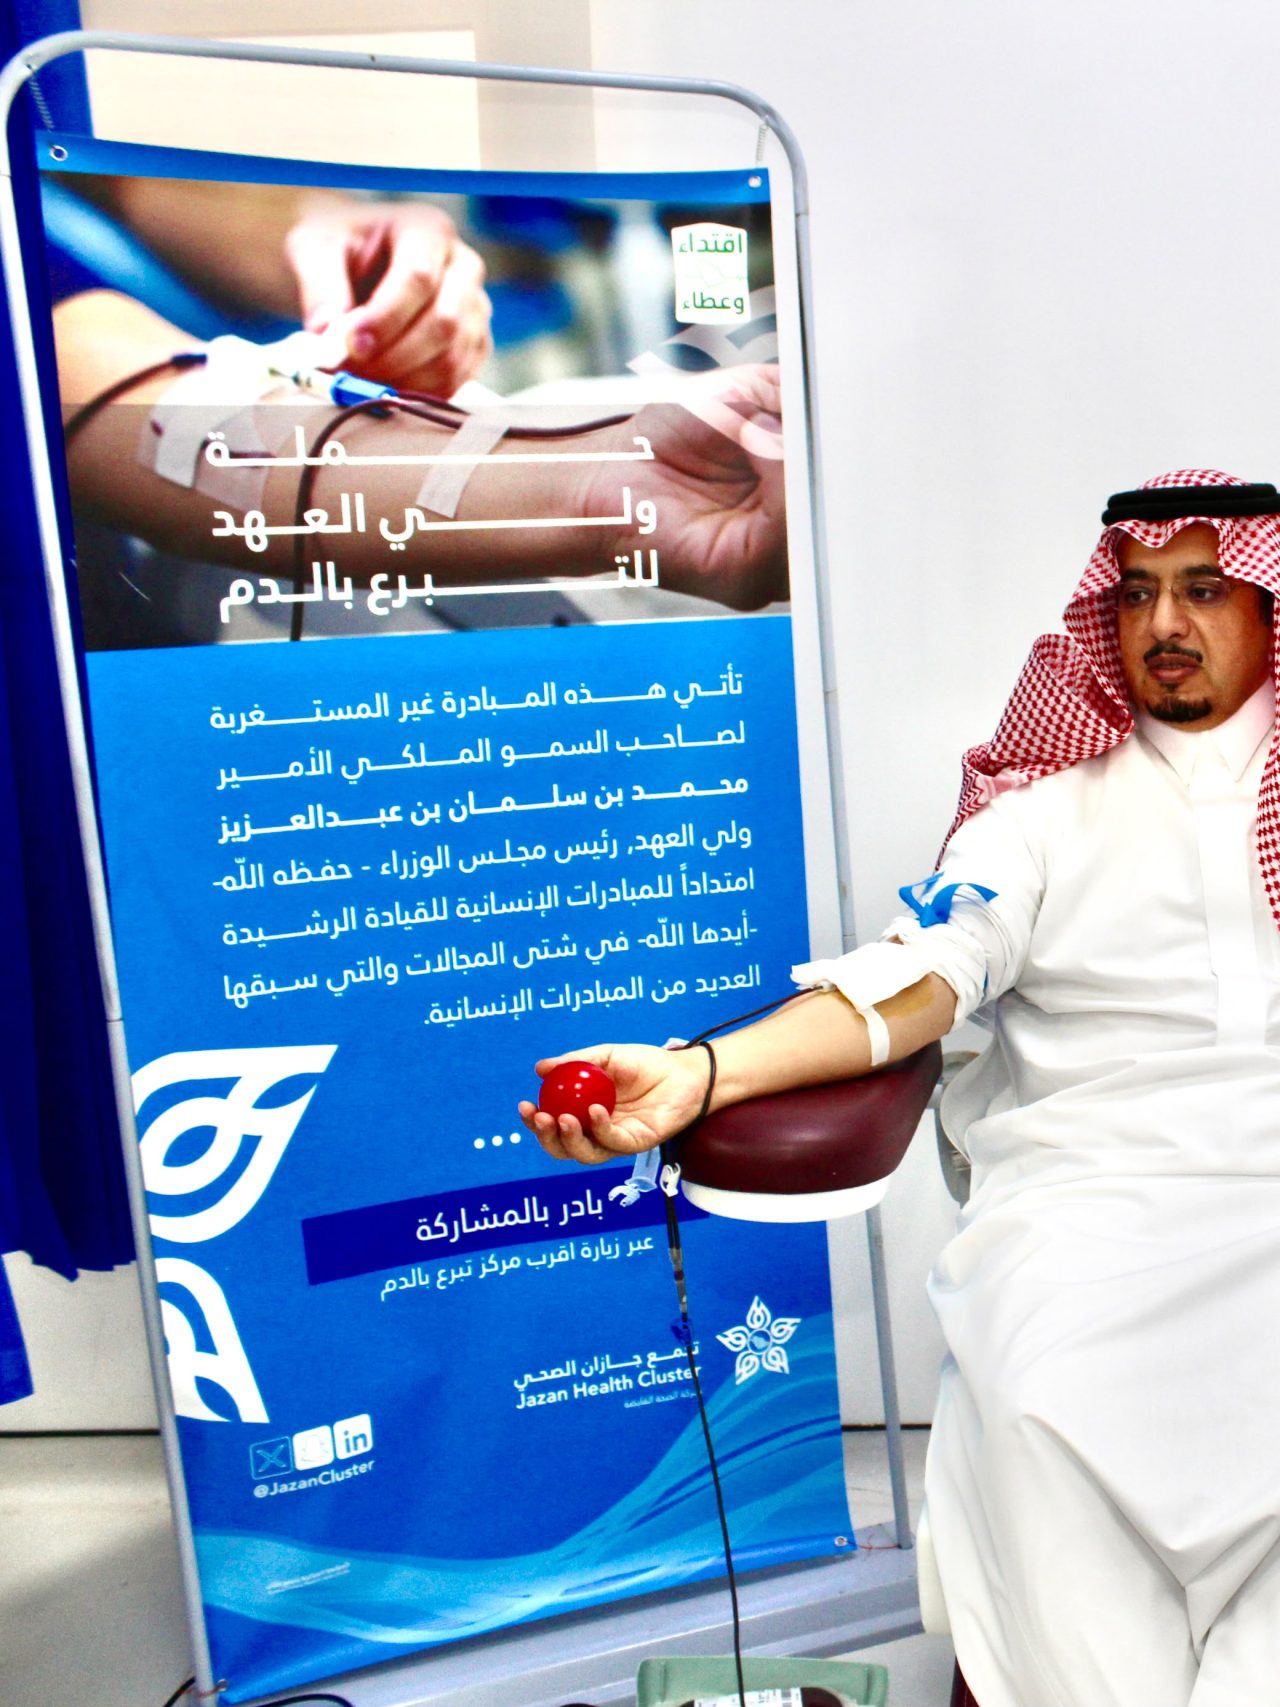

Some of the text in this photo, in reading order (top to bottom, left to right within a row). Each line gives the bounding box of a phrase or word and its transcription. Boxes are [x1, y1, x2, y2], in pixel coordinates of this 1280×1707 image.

[678, 232, 743, 254] اقتداء
[682, 291, 745, 315] وعطاء
[205, 425, 654, 466] حملة
[213, 486, 658, 553] ولي العهد
[220, 549, 658, 622] للتبرع بالدم
[209, 662, 743, 735] تأتي هذه المبادرة غير المستغربة
[215, 719, 746, 791] لصاحب السمو الملكي الأمير
[217, 777, 749, 845] محمد بن سلمان بن عبدالعزيز
[458, 838, 547, 874] مجلس
[553, 828, 618, 864] رئيس
[701, 819, 752, 857] ولي
[272, 859, 353, 886] حفظه
[380, 844, 451, 881] الوزراء
[455, 884, 560, 923] الإنسانية
[566, 874, 673, 910] للمبادرات
[222, 905, 357, 948] الرشيدة
[364, 896, 449, 931] للقيادة
[405, 940, 505, 976] المجالات
[512, 933, 577, 970] شتى
[584, 931, 630, 961] في
[223, 973, 318, 1009] سبقها
[325, 955, 399, 993] والتي
[650, 979, 687, 1004] من
[695, 964, 761, 998] العديد
[539, 975, 644, 1012] المبادرات
[415, 1188, 603, 1243] بادر بالمشاركة
[380, 1237, 654, 1302] عبر زيارة اقرب مركز تبرع بالدم
[513, 1341, 699, 1392] تمع جازان الصحي
[515, 1366, 702, 1410] Jazan Health Cluster
[253, 1460, 376, 1498] @JazanCluster
